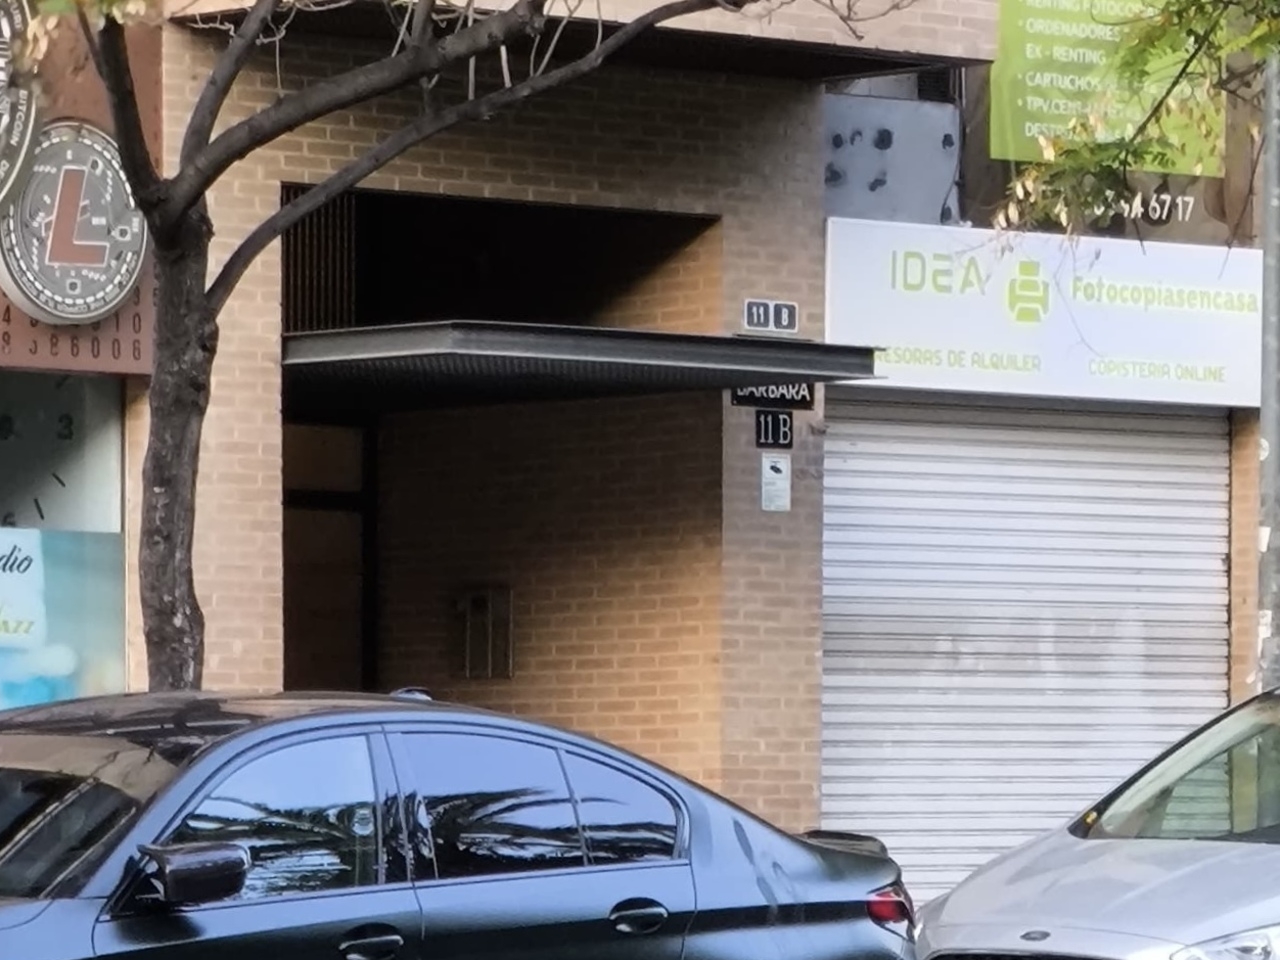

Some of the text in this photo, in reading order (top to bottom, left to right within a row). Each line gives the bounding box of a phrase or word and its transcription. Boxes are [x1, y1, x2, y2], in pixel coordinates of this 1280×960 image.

[891, 250, 986, 296] IDEA
[1072, 276, 1259, 313] Fotocopiasencasa
[947, 350, 966, 368] DE
[971, 352, 1041, 373] ALQUILER
[1175, 364, 1227, 383] ONLINE
[759, 413, 791, 444] 11 B
